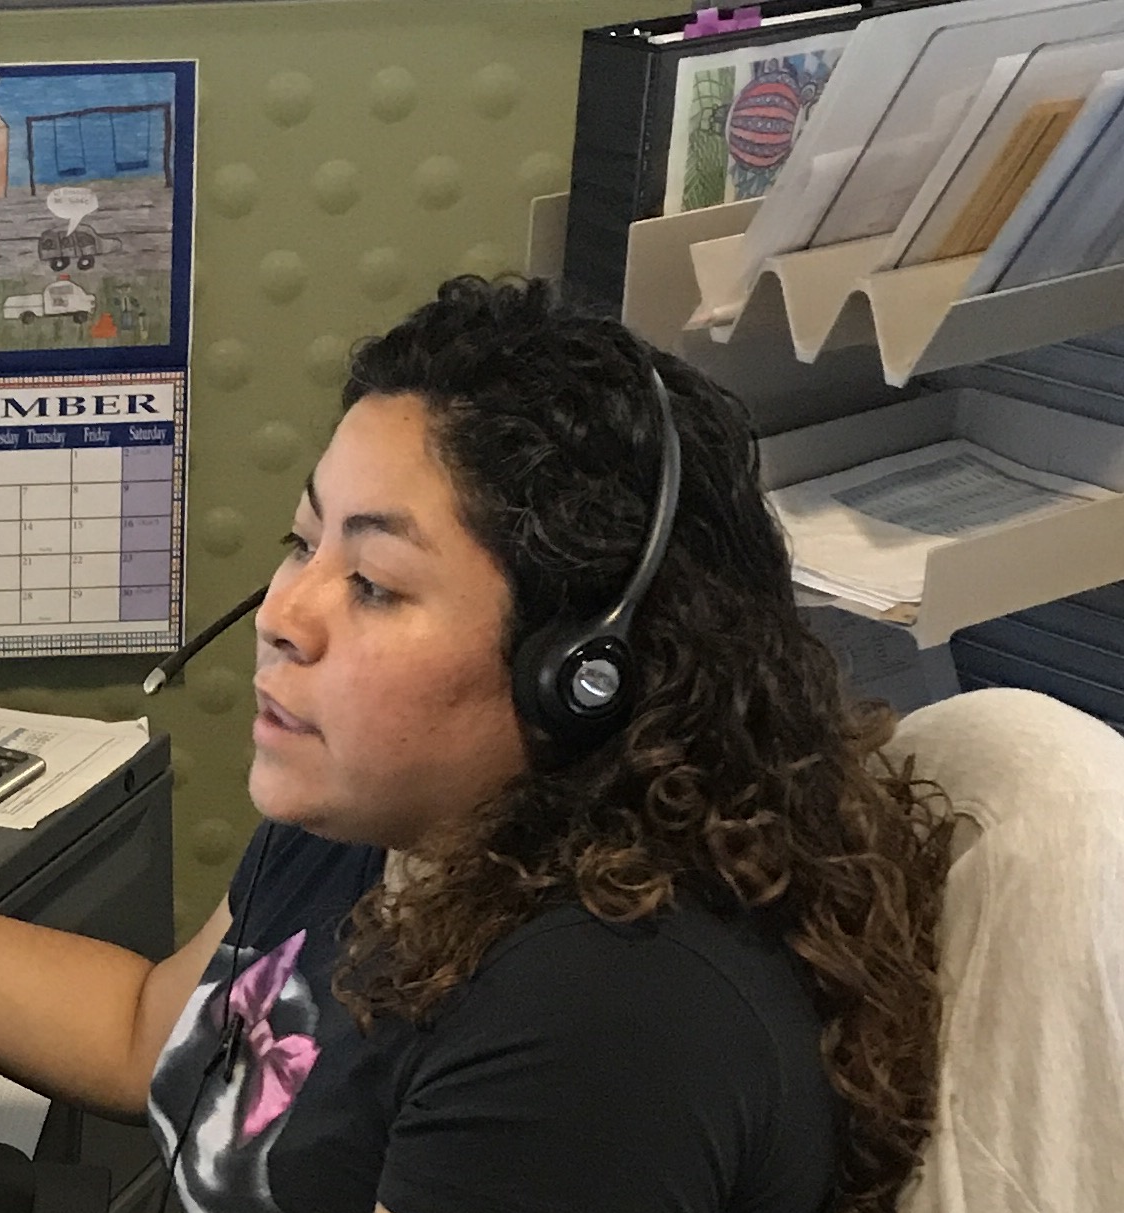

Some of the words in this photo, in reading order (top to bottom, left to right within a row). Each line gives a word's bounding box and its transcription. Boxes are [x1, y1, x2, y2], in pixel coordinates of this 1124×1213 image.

[27, 428, 67, 446] Thursday
[83, 427, 110, 444] Friday
[129, 426, 167, 443] Saturday
[23, 522, 33, 531] 14
[73, 520, 83, 529] 15
[124, 519, 134, 528] 16
[23, 558, 32, 566] 21
[23, 592, 33, 600] 28
[73, 591, 83, 599] 29
